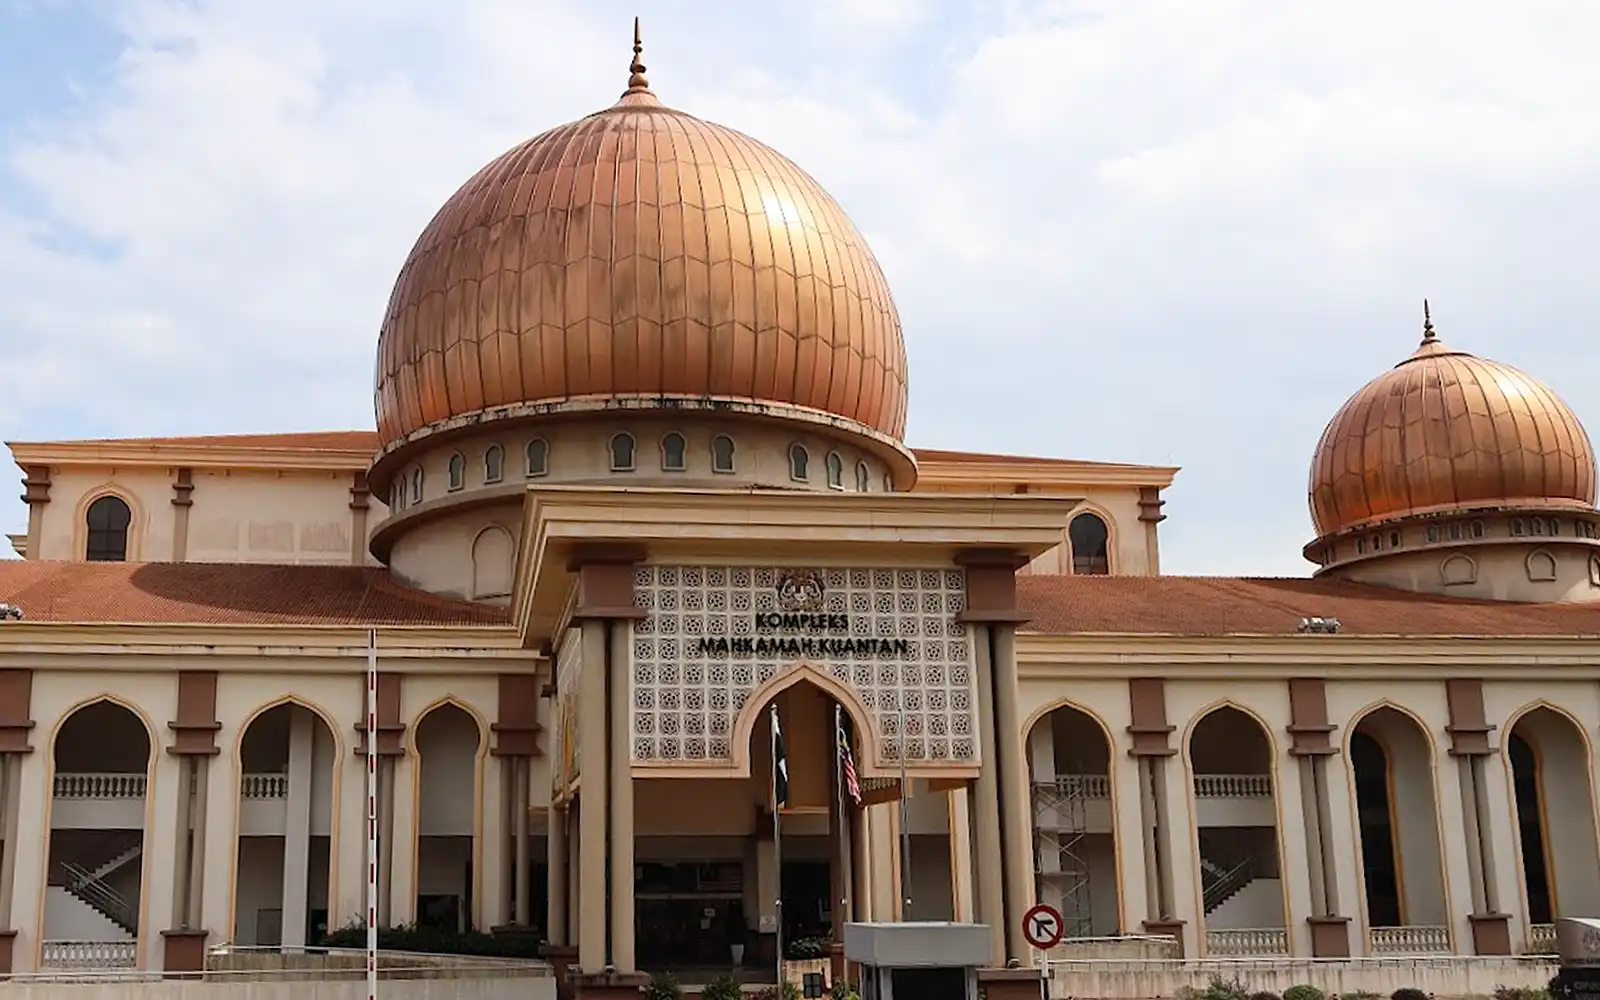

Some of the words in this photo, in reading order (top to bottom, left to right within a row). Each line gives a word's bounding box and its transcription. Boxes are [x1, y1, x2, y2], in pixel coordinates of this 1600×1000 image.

[756, 613, 848, 630] KOMPLEKS
[698, 638, 812, 653] MAHKAMAH
[820, 638, 908, 654] KUANTAN
